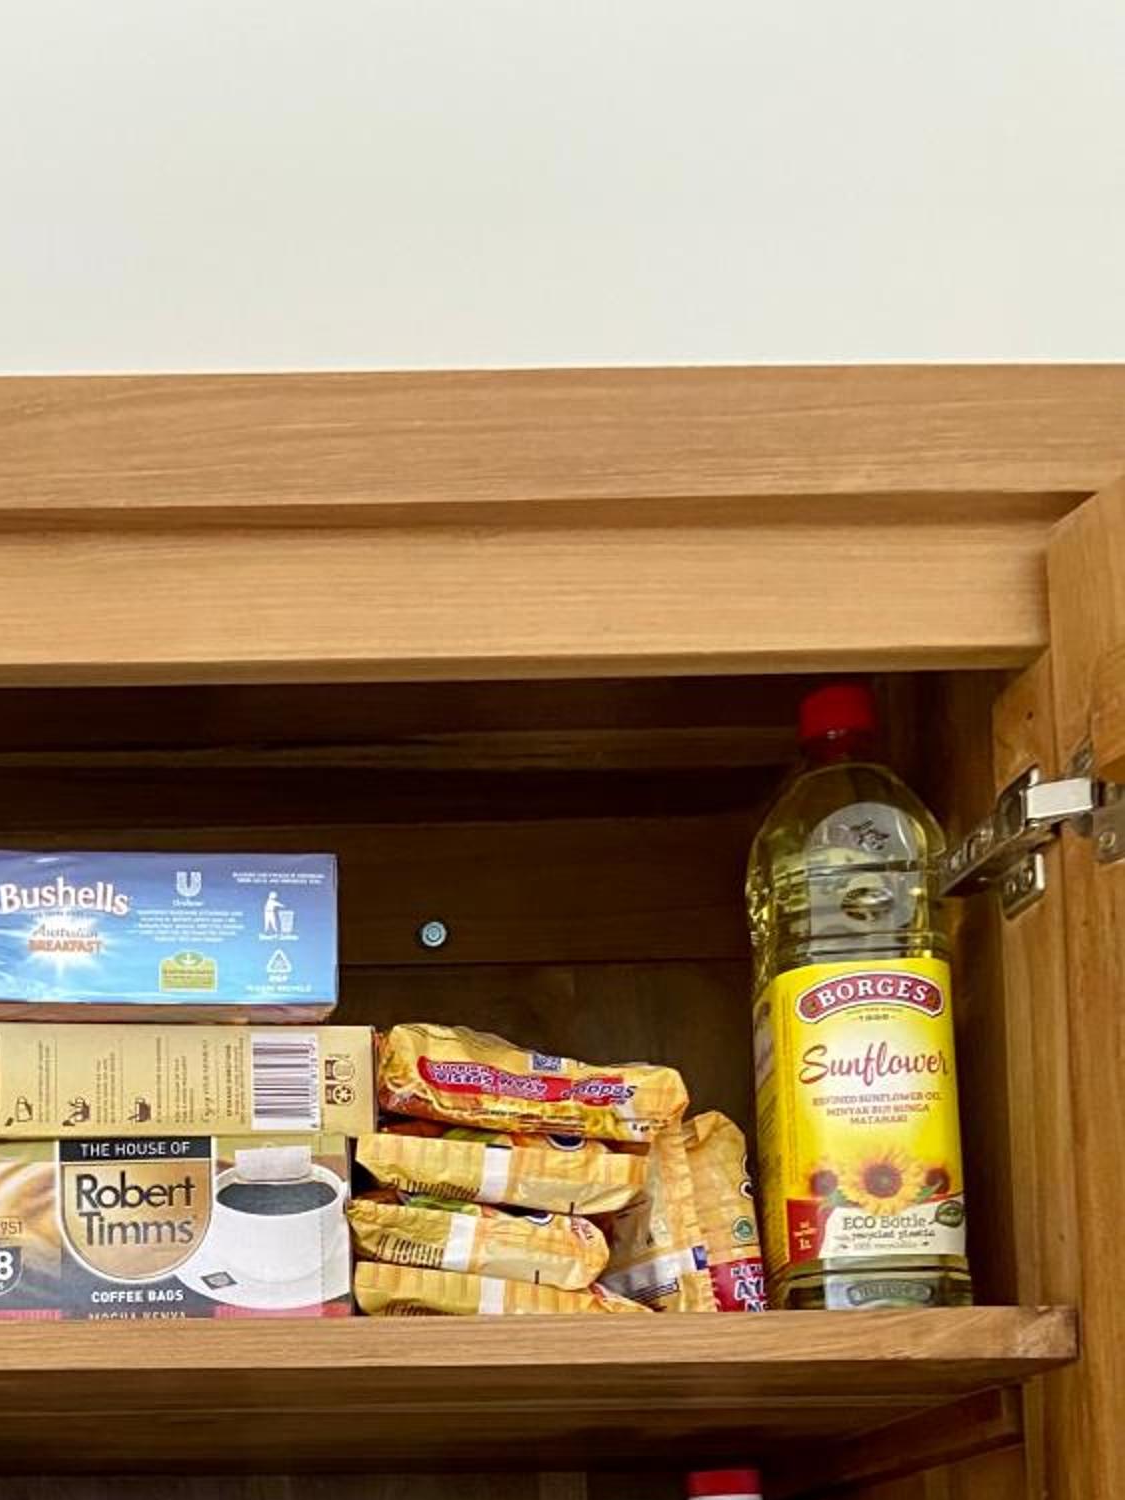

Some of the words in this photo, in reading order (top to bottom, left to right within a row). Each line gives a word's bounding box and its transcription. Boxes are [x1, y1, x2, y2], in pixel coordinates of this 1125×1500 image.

[28, 939, 101, 953] BREAKFAST
[816, 979, 929, 1008] BORGES
[799, 1041, 949, 1086] Sunflower
[81, 1143, 110, 1157] THE
[115, 1142, 166, 1156] HOUSE
[170, 1141, 191, 1155] OF
[76, 1171, 197, 1210] Robert
[78, 1211, 195, 1247] Timms
[843, 1215, 877, 1230] ECO
[880, 1213, 927, 1229] Bottle
[91, 1291, 143, 1303] COFFEE
[148, 1290, 184, 1301] BAGS
